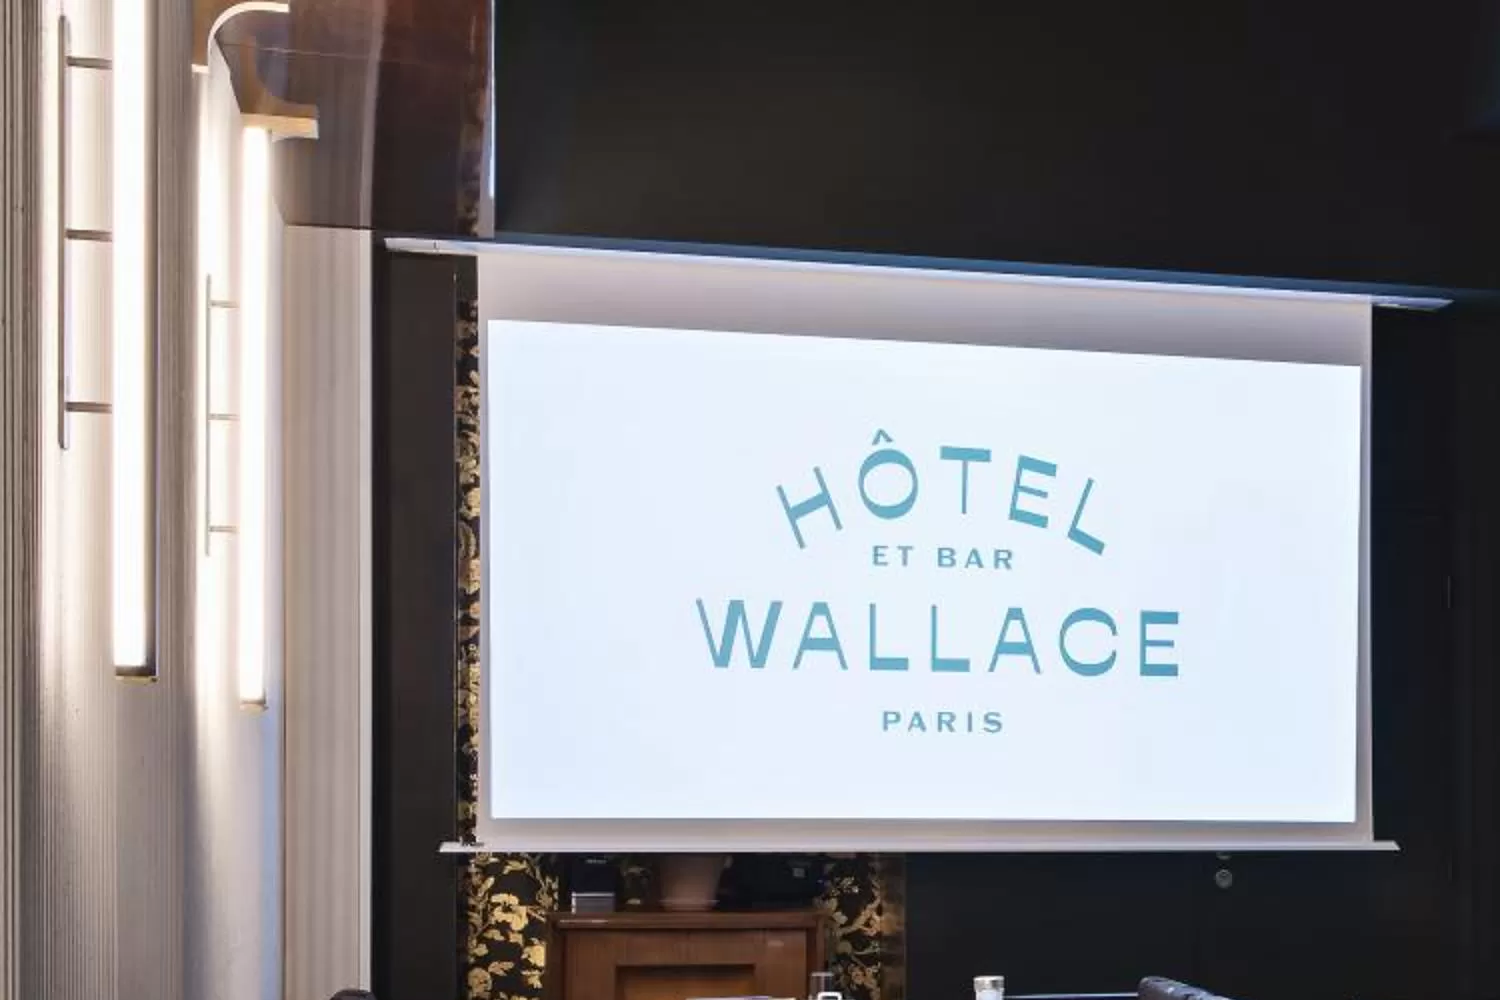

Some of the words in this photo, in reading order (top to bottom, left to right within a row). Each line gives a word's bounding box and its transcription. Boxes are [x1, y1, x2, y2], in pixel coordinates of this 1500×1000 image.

[775, 428, 1106, 556] HÔTEL
[871, 544, 914, 567] ET
[937, 547, 1013, 570] BAR
[695, 598, 1181, 678] WALLACE
[882, 710, 1003, 734] PARIS
